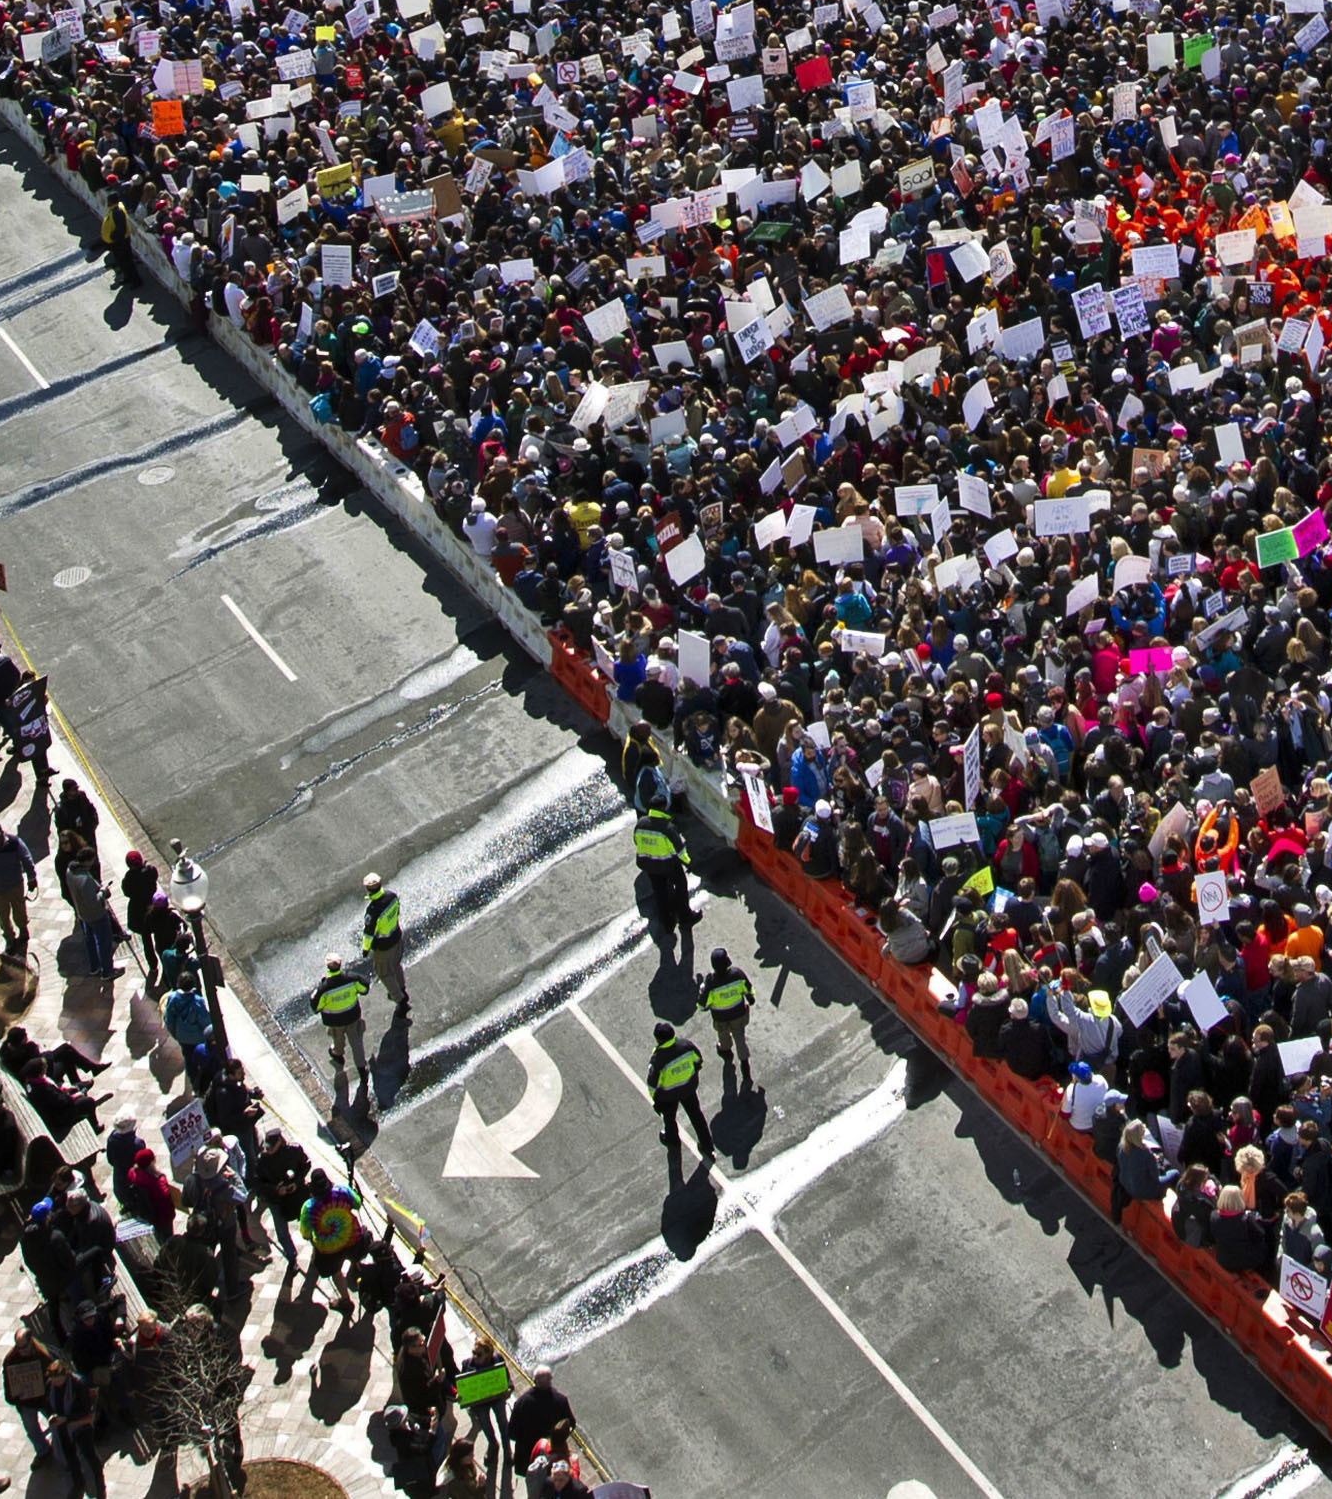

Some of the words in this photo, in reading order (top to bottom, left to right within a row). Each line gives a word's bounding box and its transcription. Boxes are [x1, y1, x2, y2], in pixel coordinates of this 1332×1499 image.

[1250, 295, 1272, 303] 2020
[738, 321, 759, 339] ENOUGH
[168, 1114, 202, 1144] BLOOD
[171, 1112, 195, 1134] NRA
